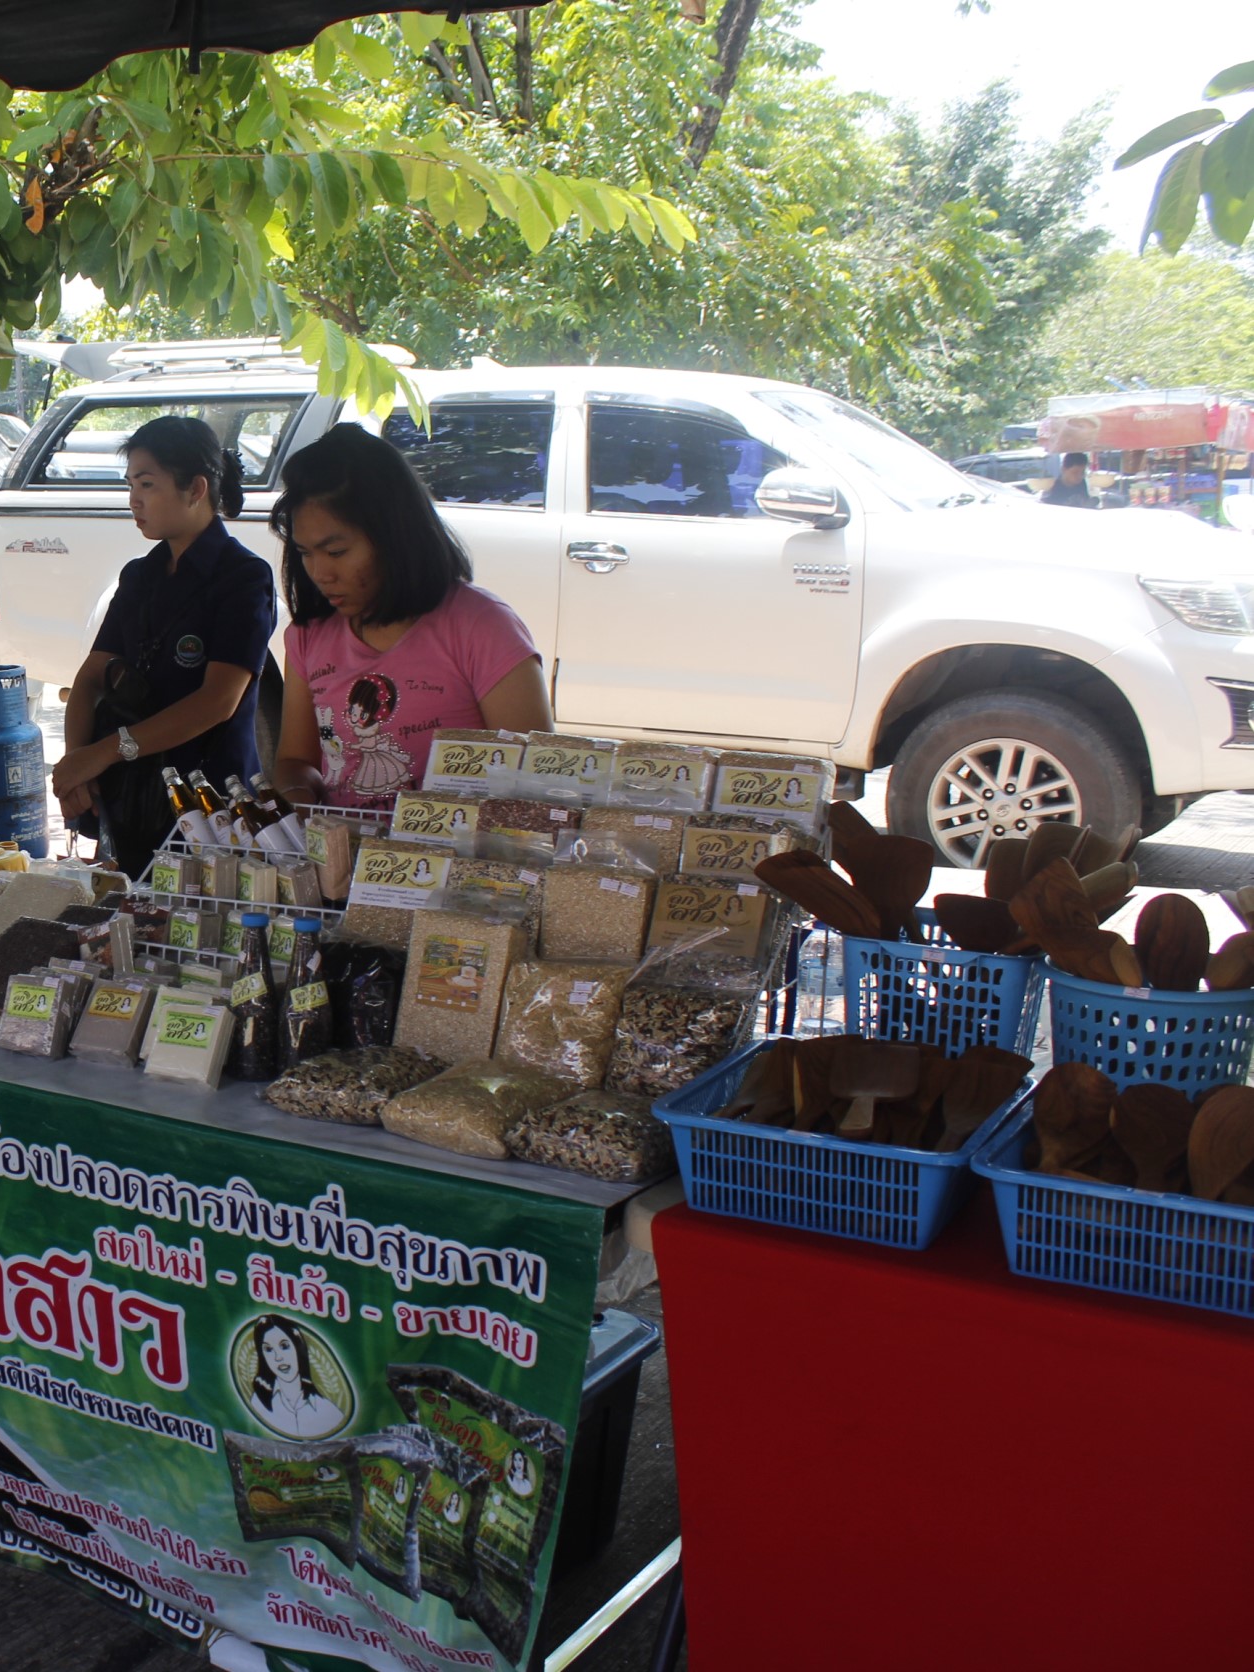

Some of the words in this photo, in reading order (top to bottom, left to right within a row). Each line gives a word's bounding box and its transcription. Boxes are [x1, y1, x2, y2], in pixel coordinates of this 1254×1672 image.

[793, 563, 851, 575] HILUX
[398, 717, 443, 739] special
[97, 1227, 205, 1286] สดใหม่
[251, 1256, 349, 1321] สีแล้ว
[396, 1302, 537, 1367] ขายเลย
